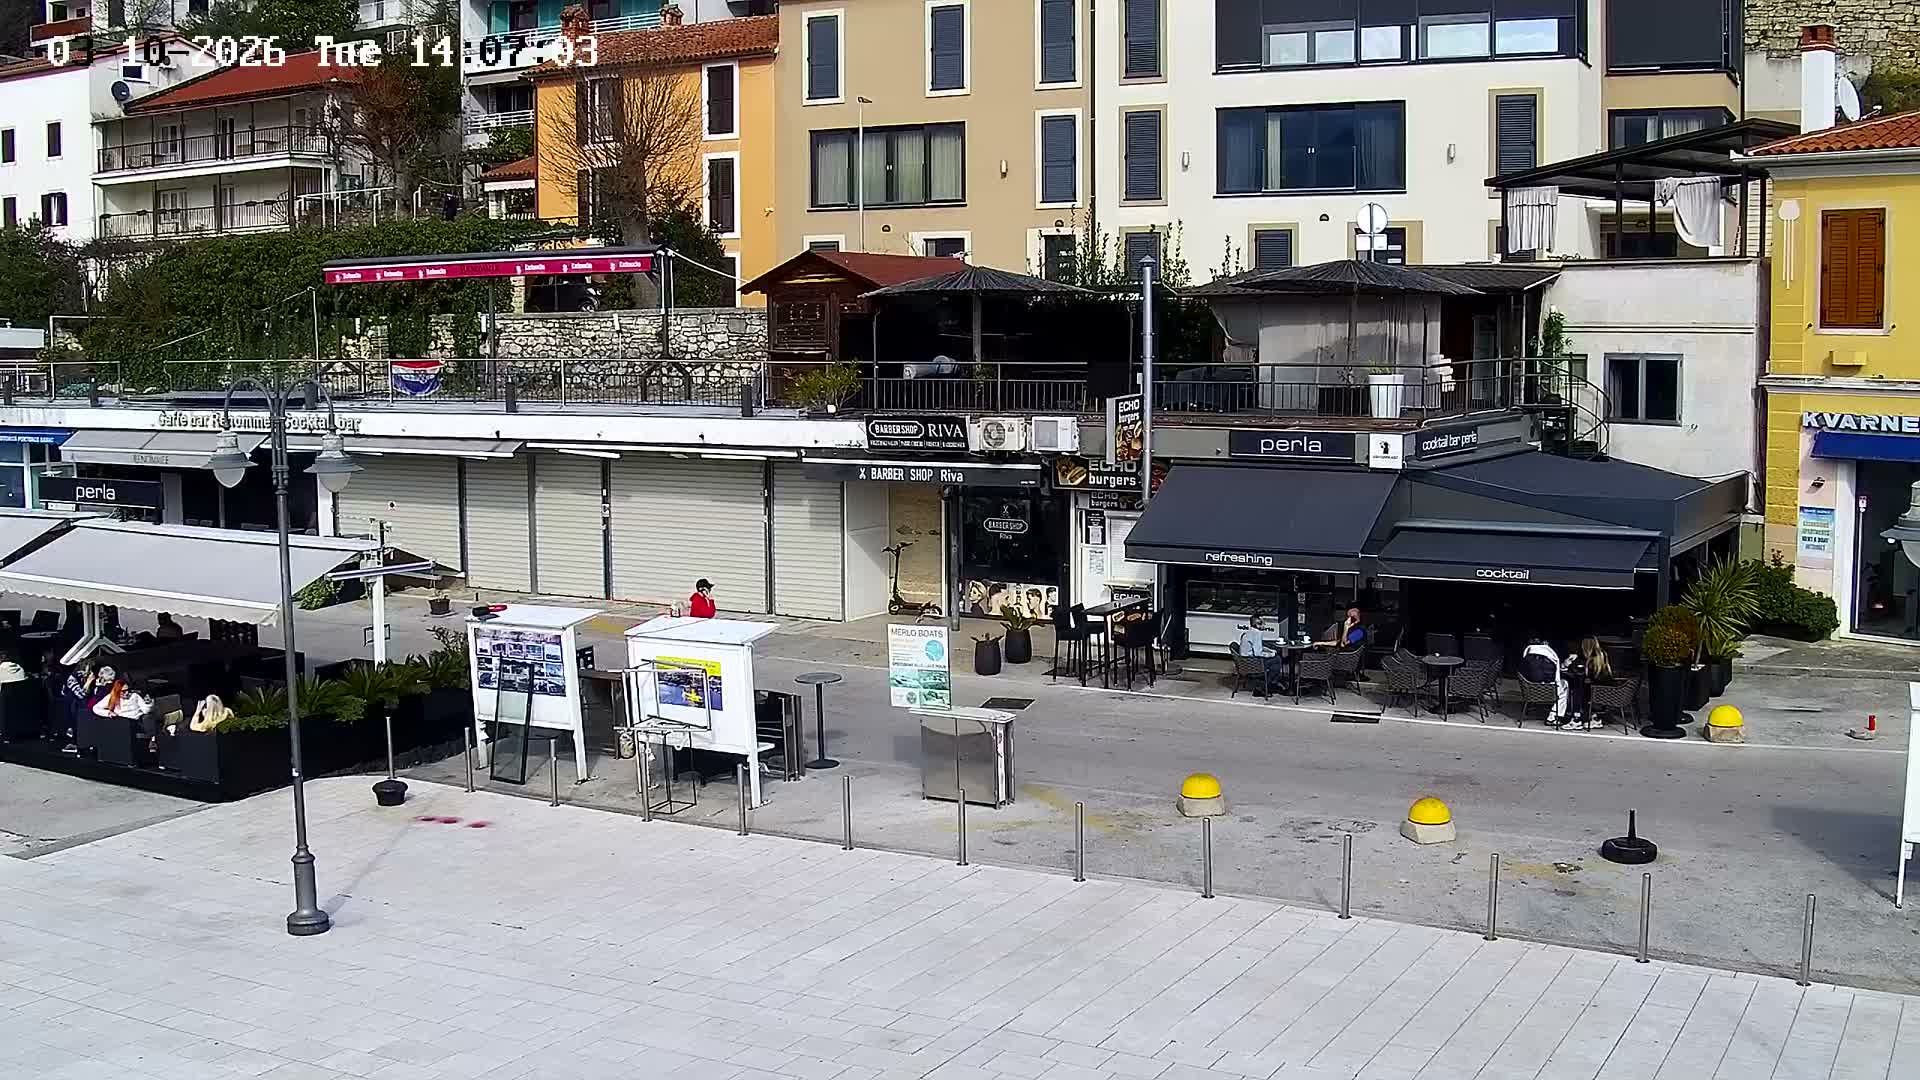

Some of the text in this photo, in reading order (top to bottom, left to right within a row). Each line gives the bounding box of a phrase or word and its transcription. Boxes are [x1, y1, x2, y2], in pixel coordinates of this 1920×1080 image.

[1118, 399, 1140, 412] ECHO
[1118, 412, 1140, 424] burgers
[1801, 411, 1920, 433] KVARNE
[874, 423, 964, 438] BARBERSHOP RIVA
[1260, 435, 1322, 454] perla
[1422, 430, 1477, 450] cocktail bar perla
[870, 467, 964, 482] BARBER SHOP Riva
[1088, 473, 1136, 488] burgers
[76, 484, 116, 500] perla
[1090, 491, 1119, 499] ECHO
[1205, 551, 1273, 566] refreshing
[1476, 568, 1530, 580] cocktail
[891, 627, 944, 638] MERLO BOATS
